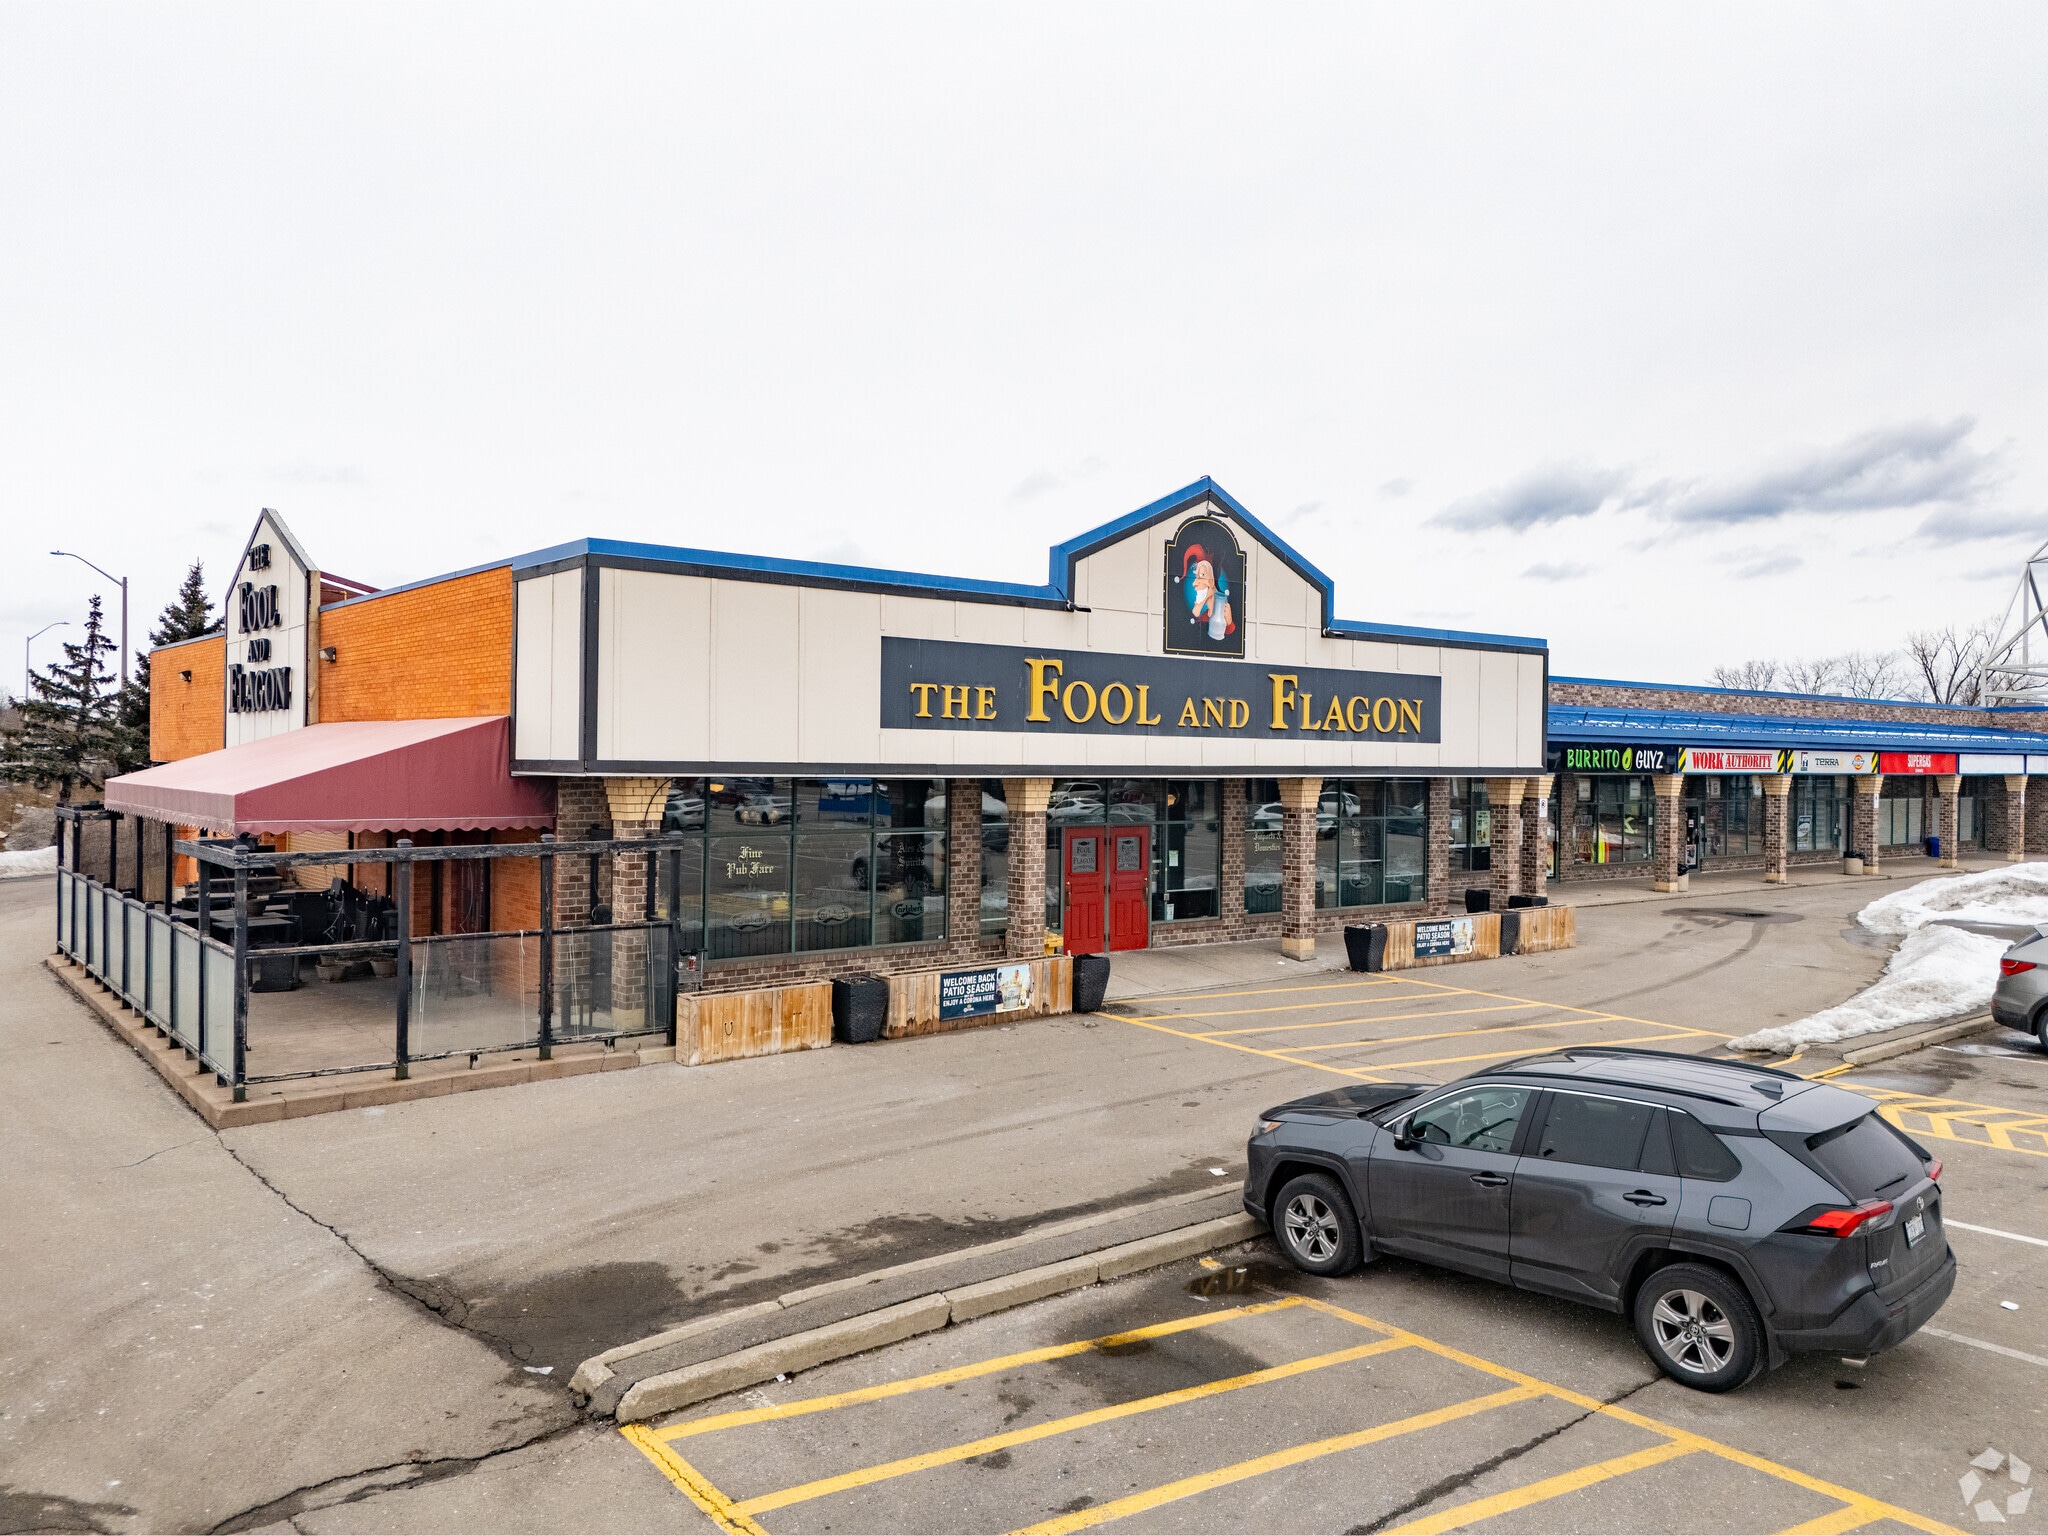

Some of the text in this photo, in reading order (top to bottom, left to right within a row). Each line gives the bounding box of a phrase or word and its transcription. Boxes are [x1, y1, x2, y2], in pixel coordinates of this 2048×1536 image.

[249, 544, 270, 571] THE
[238, 582, 281, 634] FOOL
[247, 638, 271, 662] AND
[228, 664, 291, 713] FLAGON
[910, 658, 1423, 734] THE FOOL AND FLAGON
[1567, 749, 1664, 769] BURRITO GUYZ
[1692, 751, 1772, 769] WORK AUTHORITY
[738, 846, 763, 862] Fine
[726, 862, 774, 878] Pub Fare
[1431, 931, 1450, 939] SEASON
[943, 973, 995, 987] WELCOME BACK
[943, 982, 995, 997] PATIO SEASON
[943, 999, 959, 1007] ENJOY
[964, 996, 982, 1004] CORONA
